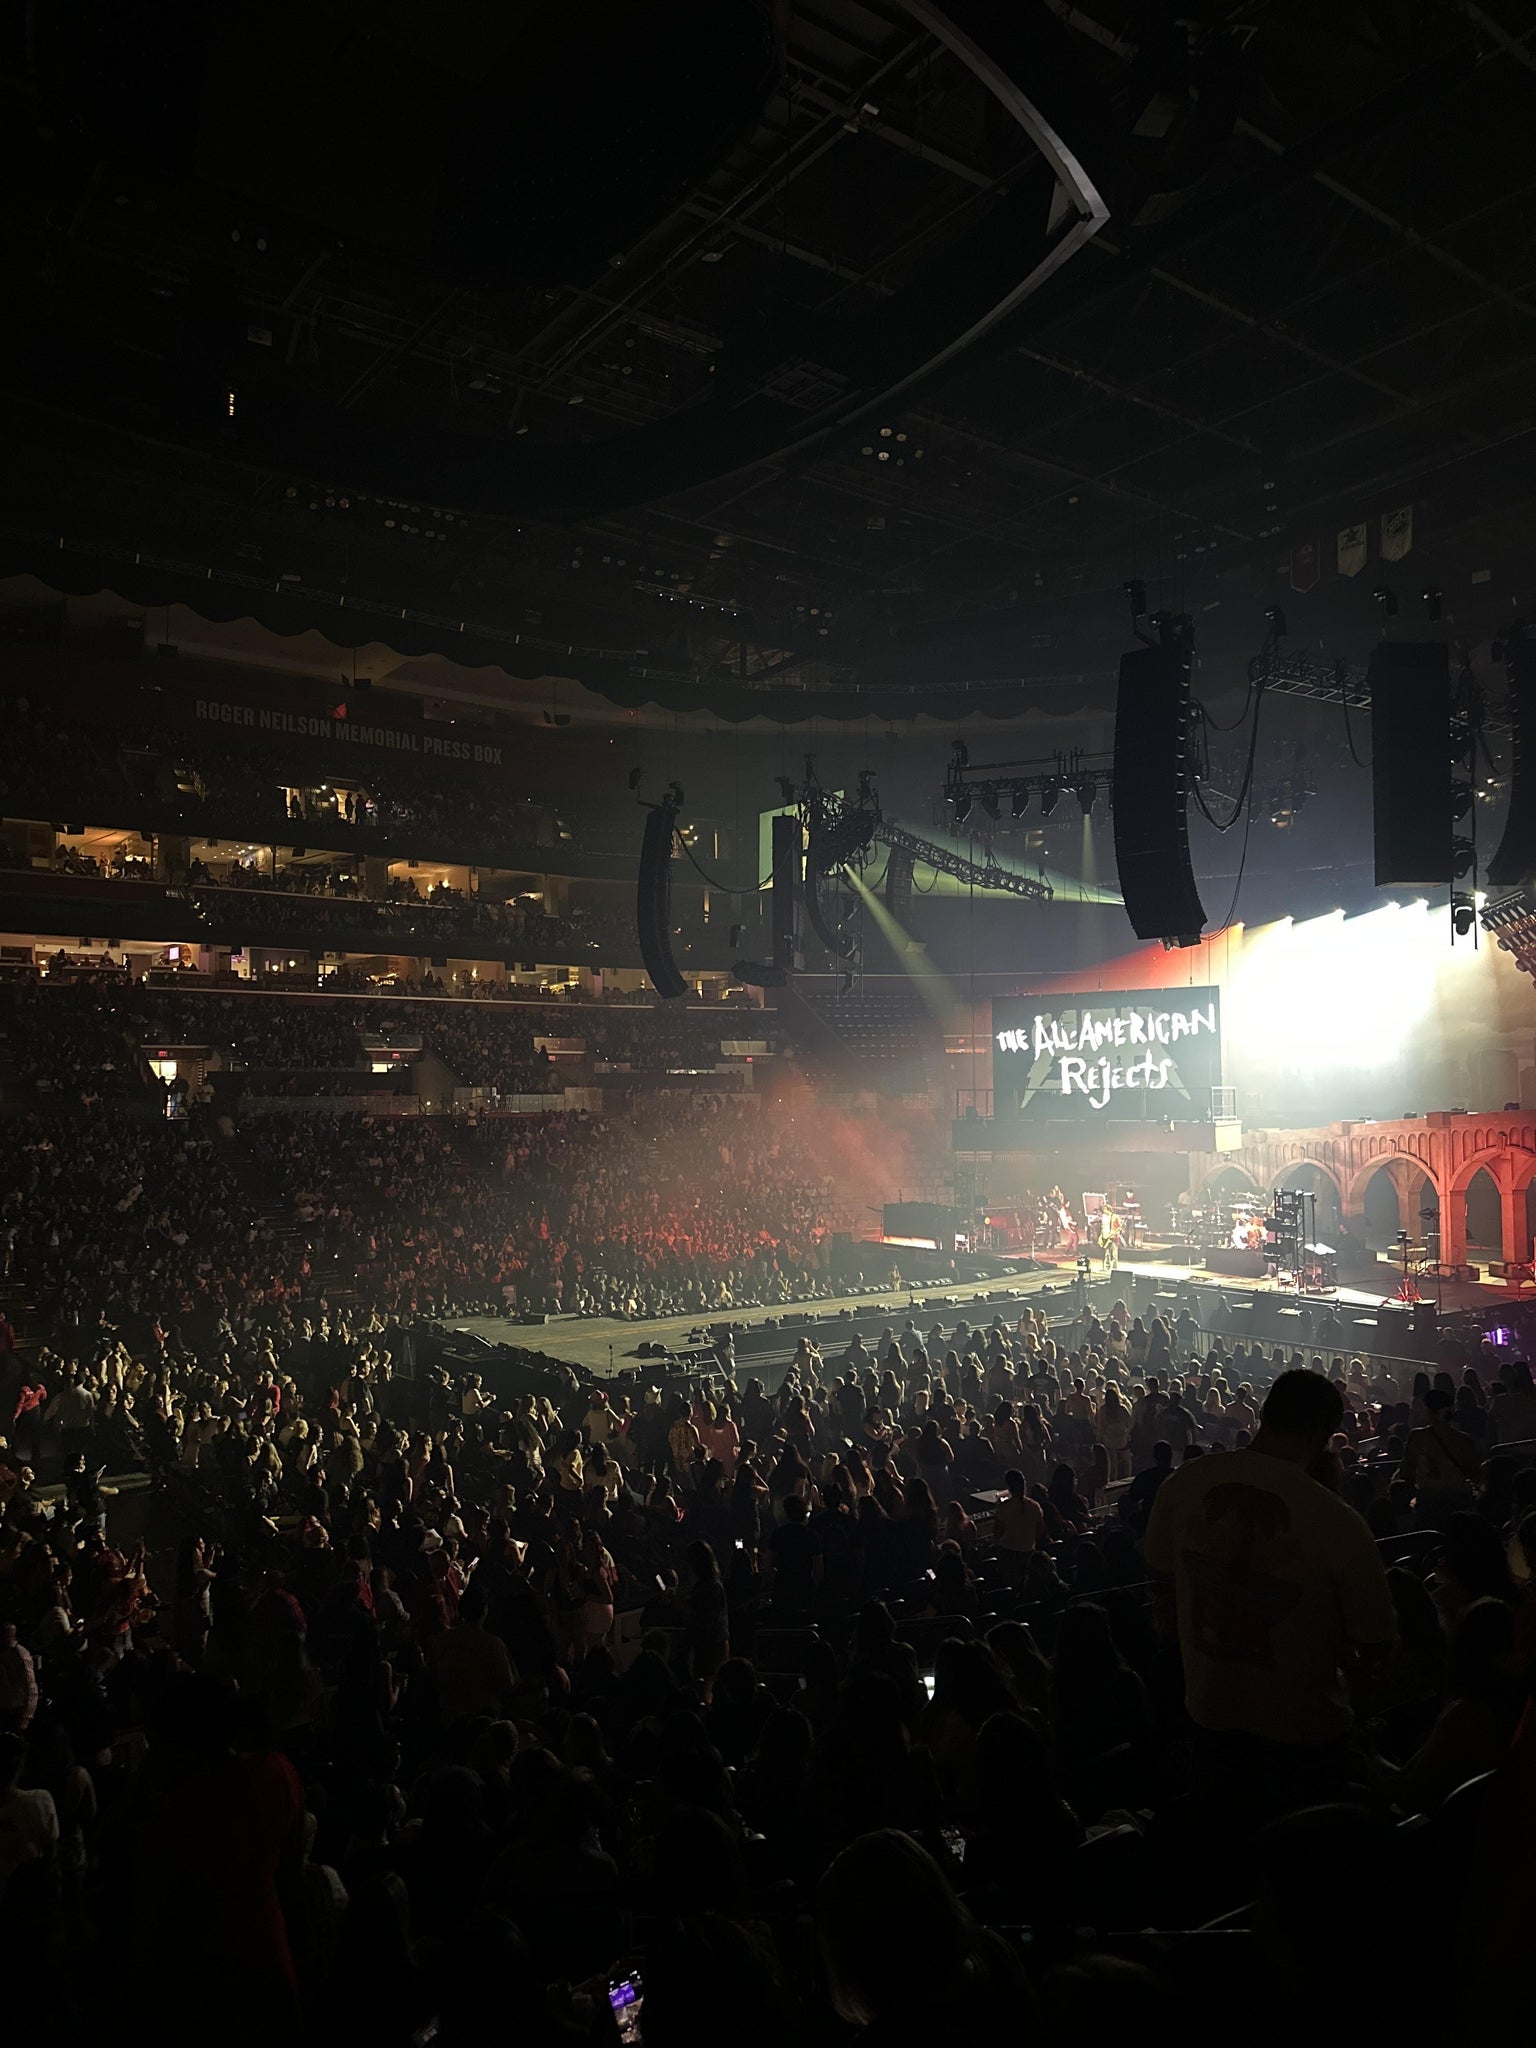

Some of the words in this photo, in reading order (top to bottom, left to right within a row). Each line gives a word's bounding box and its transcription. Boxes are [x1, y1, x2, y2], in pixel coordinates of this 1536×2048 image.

[196, 700, 254, 725] ROGER
[259, 710, 332, 737] NEILSON
[335, 723, 419, 751] MEMORIAL
[423, 736, 470, 760] PRESS
[473, 744, 503, 766] BOX
[996, 1028, 1029, 1053] THE
